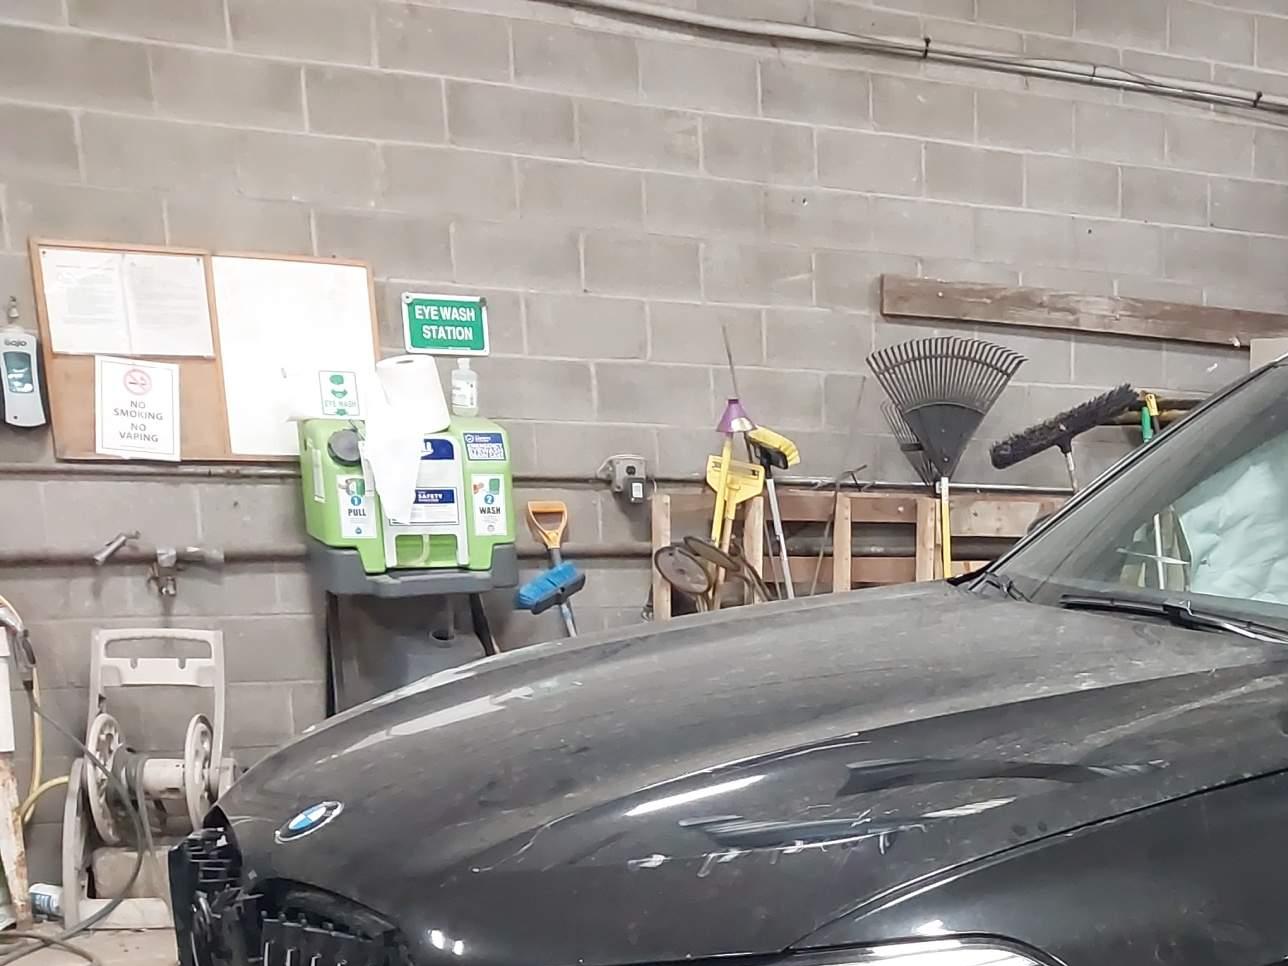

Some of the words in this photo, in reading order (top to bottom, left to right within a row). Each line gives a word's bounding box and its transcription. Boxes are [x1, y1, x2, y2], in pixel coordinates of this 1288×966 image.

[414, 304, 440, 320] EYE
[440, 306, 477, 322] WASH
[422, 324, 474, 341] STATION
[130, 400, 147, 409] NO
[113, 408, 164, 421] SMOKING
[130, 422, 147, 432] NO
[119, 431, 160, 443] VAPING
[347, 508, 367, 517] PULL
[479, 506, 501, 515] WASH
